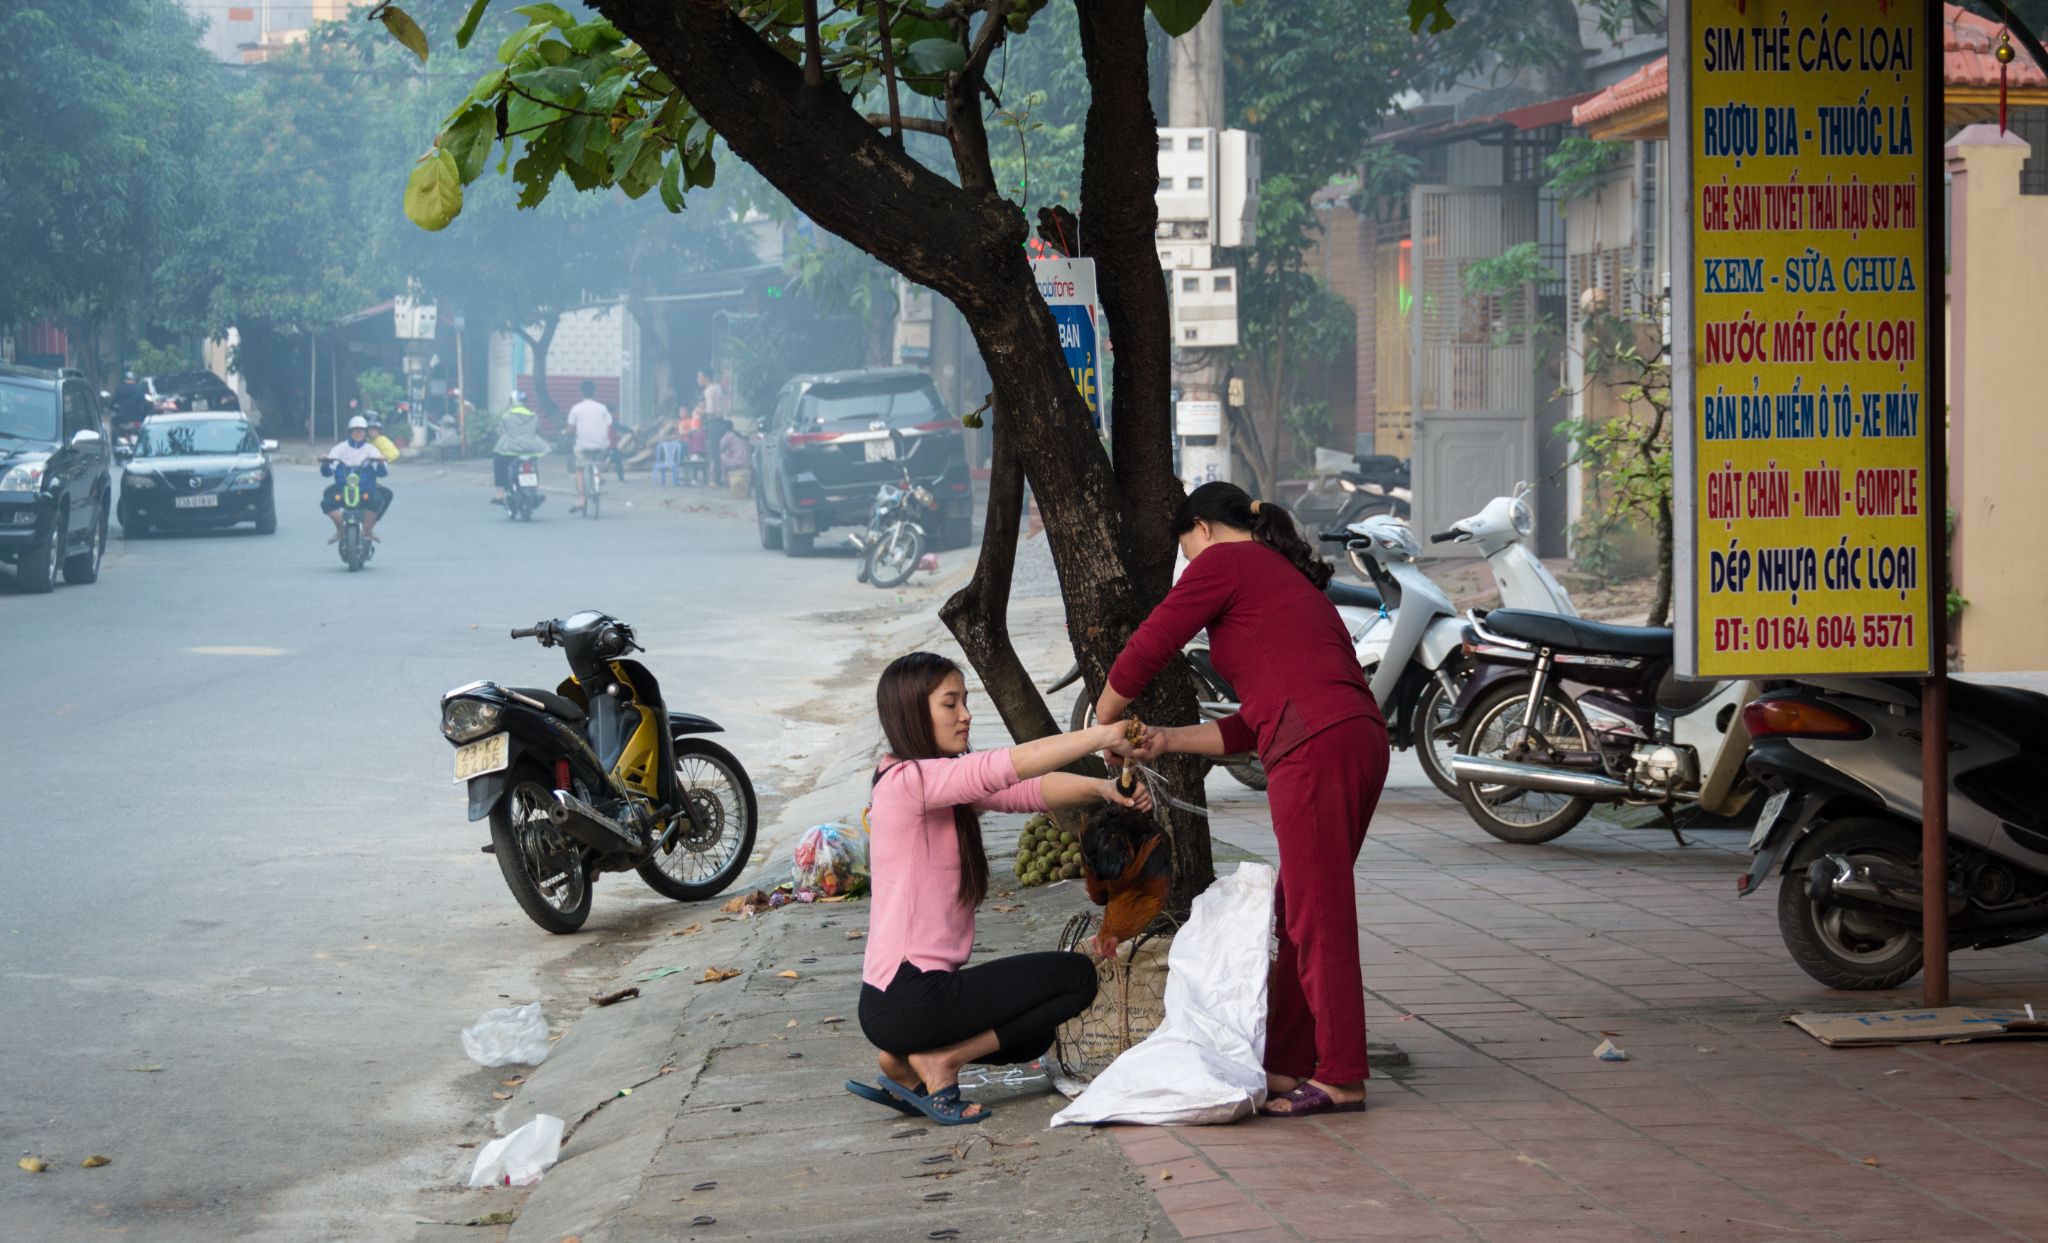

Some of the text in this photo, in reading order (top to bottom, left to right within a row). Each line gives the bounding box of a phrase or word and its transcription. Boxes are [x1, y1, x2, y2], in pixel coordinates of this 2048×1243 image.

[1704, 10, 1912, 82] SIM THẺ CÁC LOẠI
[1704, 102, 1758, 168] RƯỢU
[1765, 107, 1798, 156] BIA
[1818, 89, 1882, 155] THUỐC
[1889, 96, 1913, 155] LÁ
[1703, 169, 1915, 240] CHÈ SAN TUYẾT THÁI HẬU SU PHÌ
[1037, 276, 1074, 297] obifone
[1704, 259, 1764, 293] KEM
[1785, 249, 1836, 292] SỮA
[1844, 257, 1916, 291] CHUA
[1058, 318, 1080, 348] BÁN
[1706, 310, 1915, 372] NƯỚC MÁT CÁC LOẠI
[1070, 351, 1096, 411] HẺ
[1705, 386, 1736, 440] BÁN
[1741, 376, 1771, 439] BẢO
[1776, 376, 1814, 438] HIỂM
[1819, 384, 1829, 438] Ô
[1886, 384, 1919, 437] MÁY
[1708, 461, 1742, 529] GIẶT
[1747, 461, 1789, 518] CHĂN
[1804, 460, 1840, 517] MÀN
[1856, 469, 1918, 516] COMPLE
[1710, 535, 1916, 606] DÉP NHỰA CÁC LOẠI
[1715, 614, 1913, 651] ĐT: 0164 604 5571
